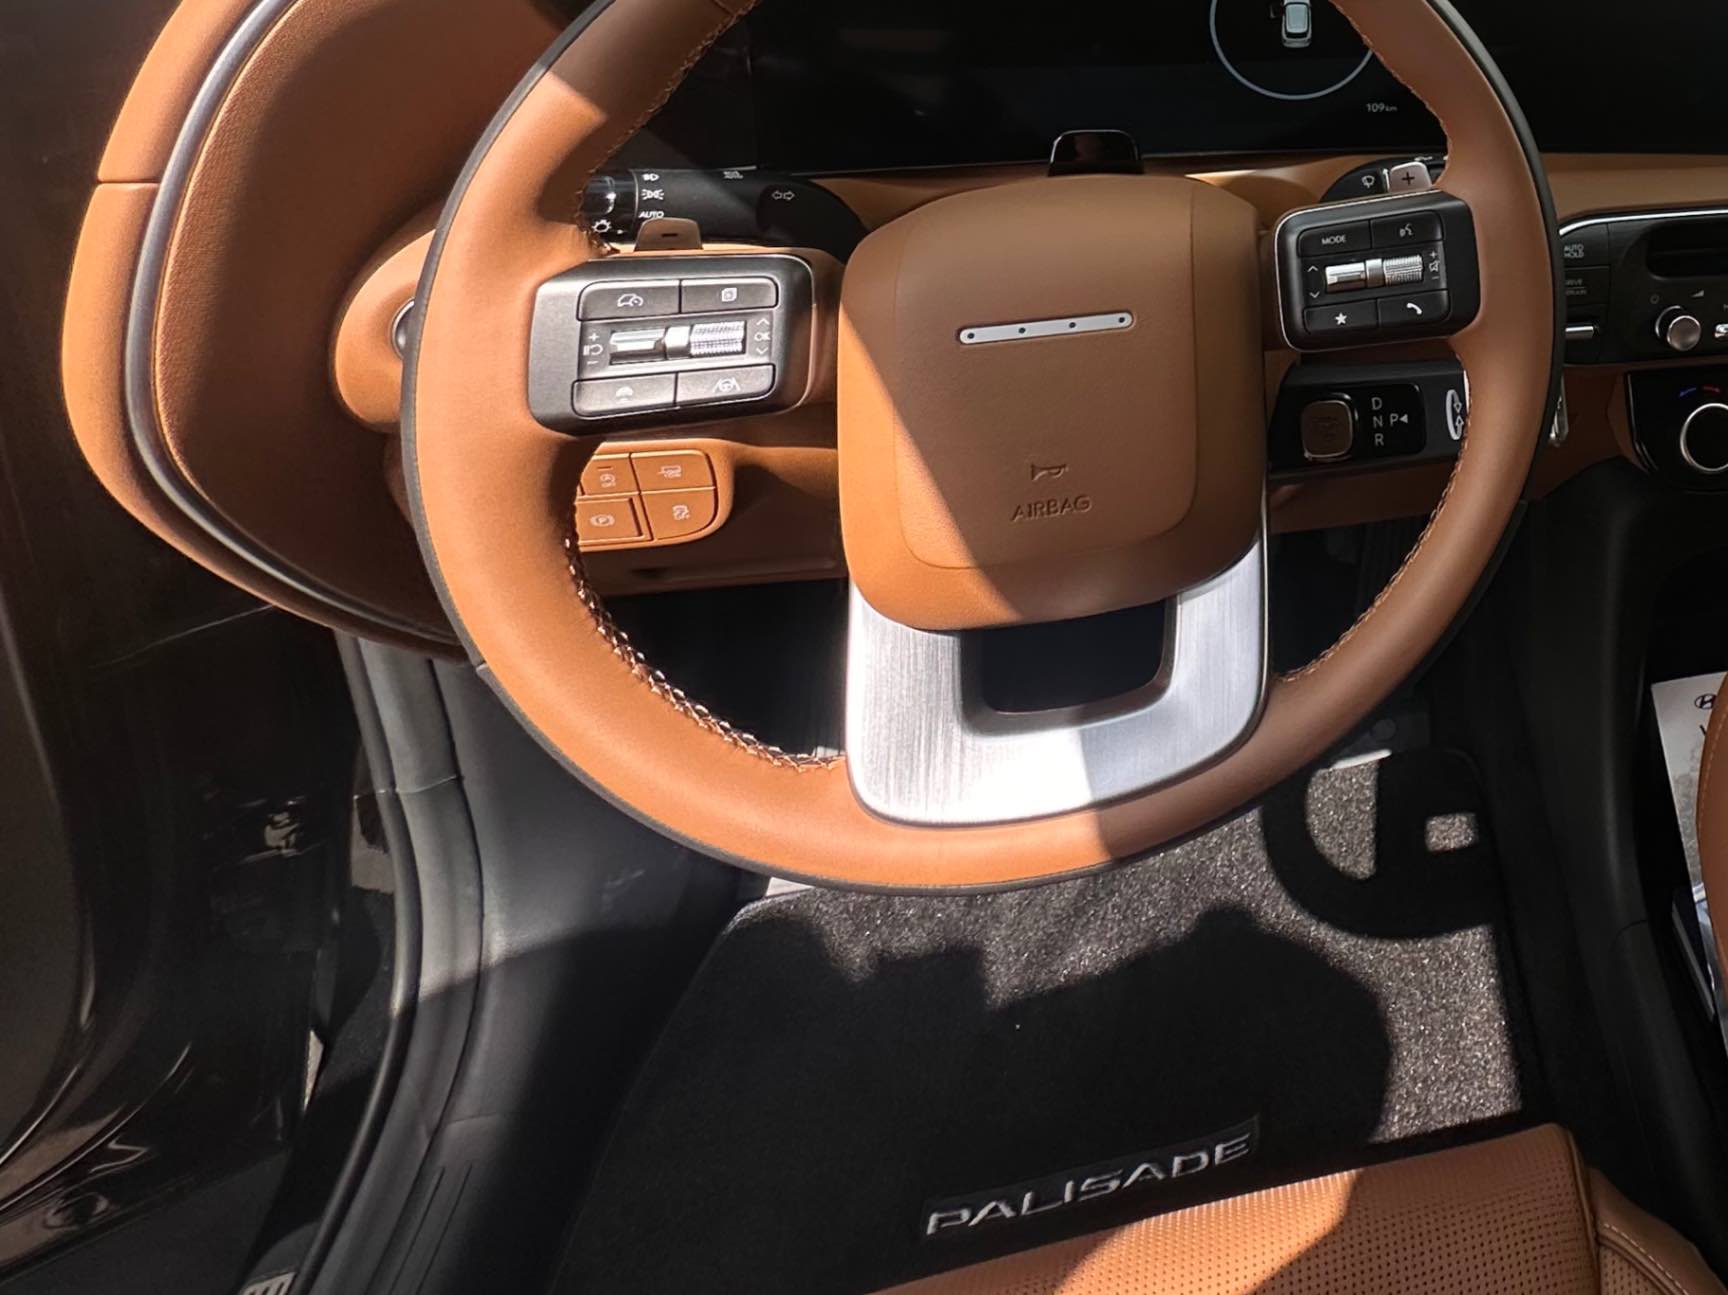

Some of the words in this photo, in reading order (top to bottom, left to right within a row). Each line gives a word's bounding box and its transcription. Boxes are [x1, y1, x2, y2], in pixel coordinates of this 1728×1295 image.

[638, 210, 665, 219] AUTO
[1321, 234, 1347, 245] MODE
[1371, 397, 1383, 411] D
[1372, 415, 1384, 429] N
[1389, 413, 1399, 427] P
[1374, 433, 1385, 447] R
[1010, 494, 1093, 522] AIRBAG
[926, 1133, 1252, 1236] PALISADE
